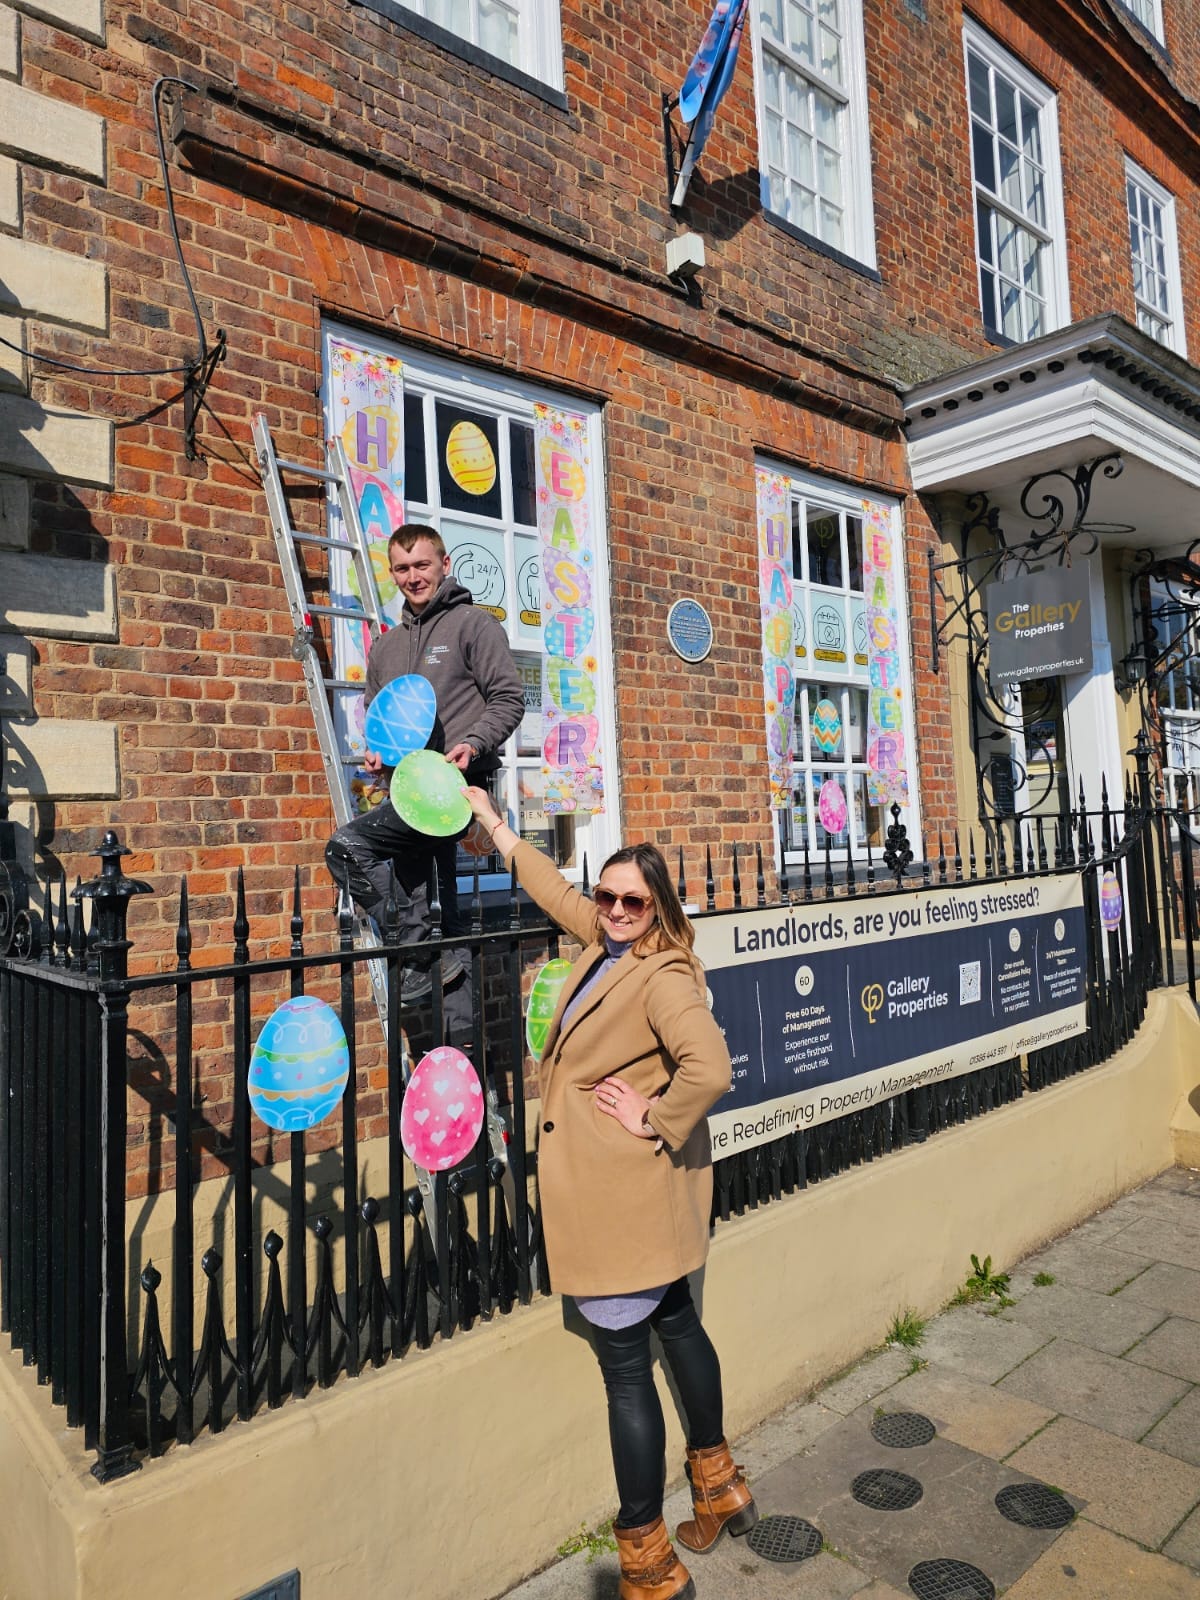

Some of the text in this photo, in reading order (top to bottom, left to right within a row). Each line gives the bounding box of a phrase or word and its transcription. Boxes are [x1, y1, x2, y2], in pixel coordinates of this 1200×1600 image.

[477, 563, 499, 576] 24/7
[551, 451, 587, 766] EASTER
[995, 599, 1082, 632] Gallery
[1012, 603, 1029, 614] The
[766, 518, 789, 752] HAPPY
[1015, 622, 1064, 639] Properties
[871, 534, 897, 769] EASTER
[997, 657, 1085, 678] www.galleryproperties.uk
[525, 698, 541, 706] AYS
[734, 887, 1040, 953] Landlords, are you feeling stressed?
[799, 976, 810, 986] 60
[887, 976, 930, 998] Gallery
[785, 1005, 825, 1021] Free 60 Days
[887, 990, 949, 1019] Properties
[782, 1015, 832, 1034] of Management
[785, 1033, 830, 1051] Experience our
[784, 1042, 833, 1064] service firsthand
[793, 1057, 830, 1075] without risk
[733, 1103, 814, 1143] Redefining
[819, 1084, 877, 1115] Property
[879, 1059, 955, 1092] Management
